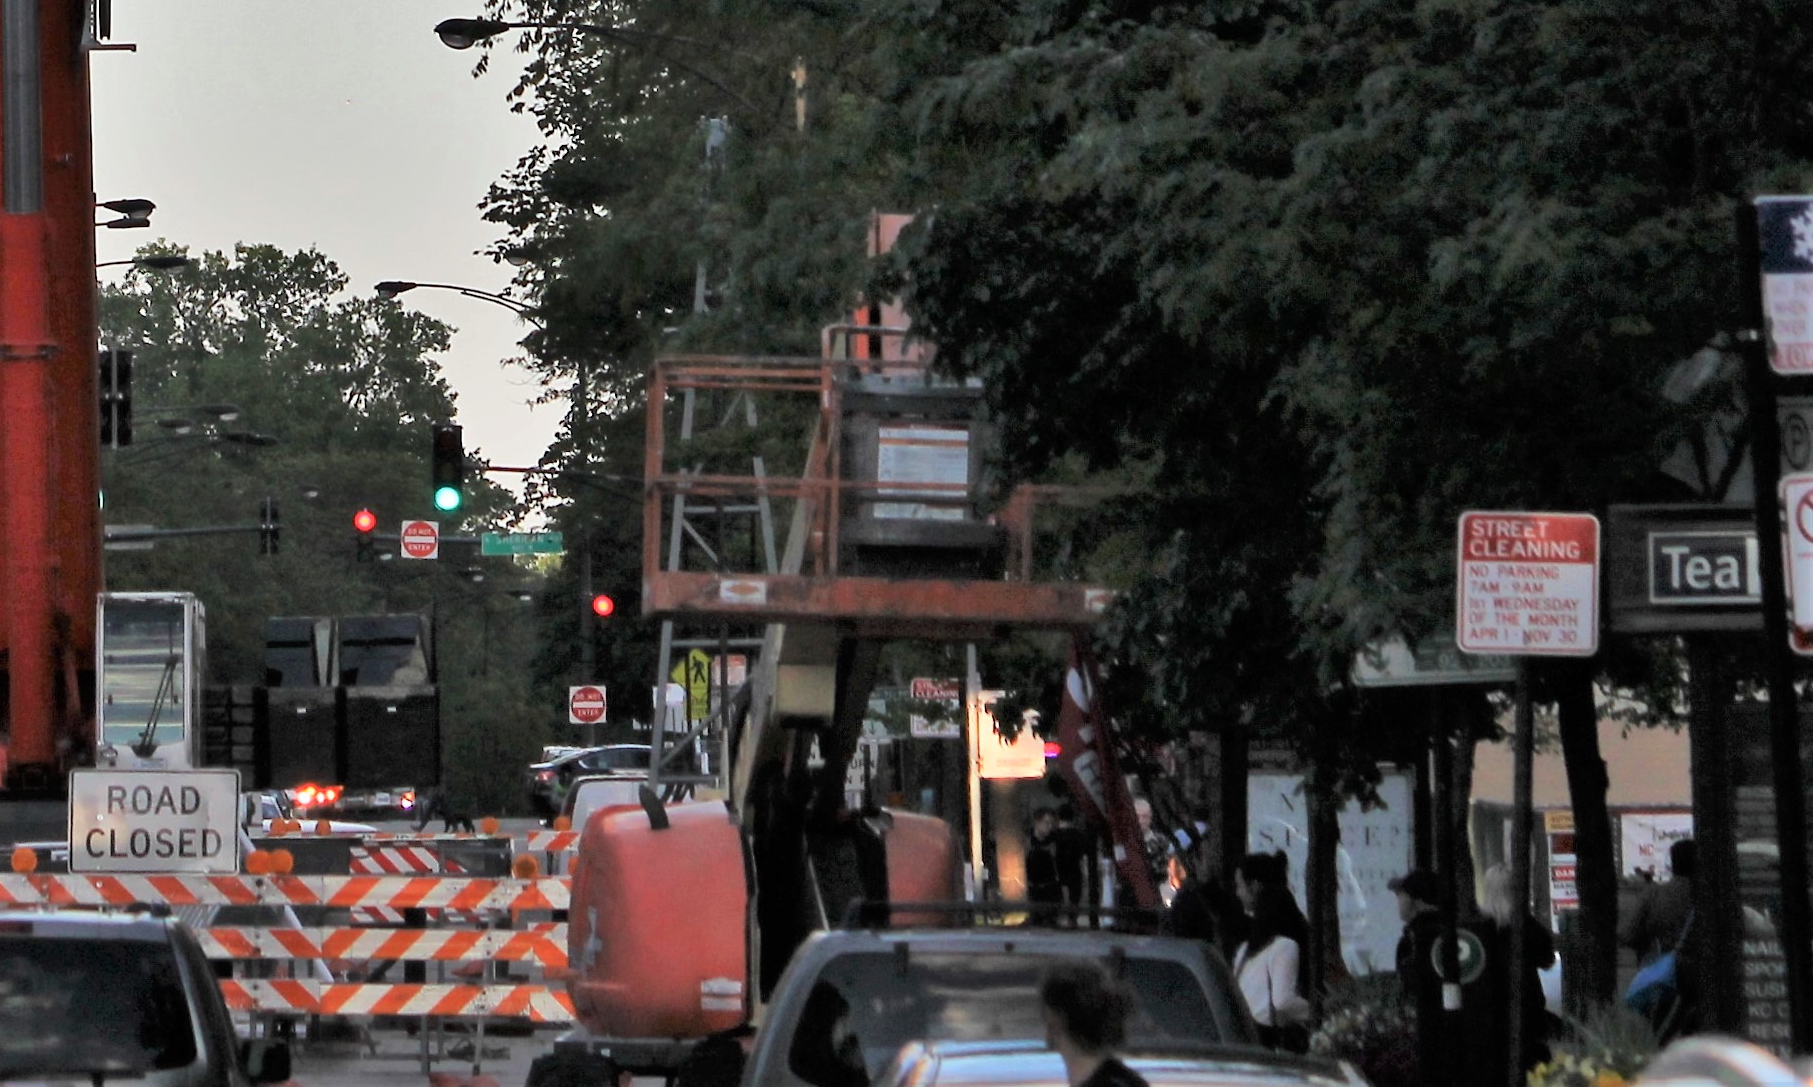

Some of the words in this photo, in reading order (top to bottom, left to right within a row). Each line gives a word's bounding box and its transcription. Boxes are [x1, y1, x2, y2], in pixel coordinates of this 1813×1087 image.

[1471, 519, 1549, 539] STREET
[1469, 538, 1580, 559] CLEANING
[1469, 565, 1489, 578] NO
[1497, 565, 1561, 580] PARKING
[1661, 545, 1740, 590] Tea
[1493, 597, 1579, 611] WEDNESDAY
[1469, 612, 1486, 625] OF
[1496, 612, 1520, 626] THE
[1528, 613, 1579, 627] MONTH
[1469, 627, 1499, 640] APR
[915, 690, 959, 700] CLEANIN
[107, 785, 201, 815] ROAD
[86, 827, 222, 858] CLOSED
